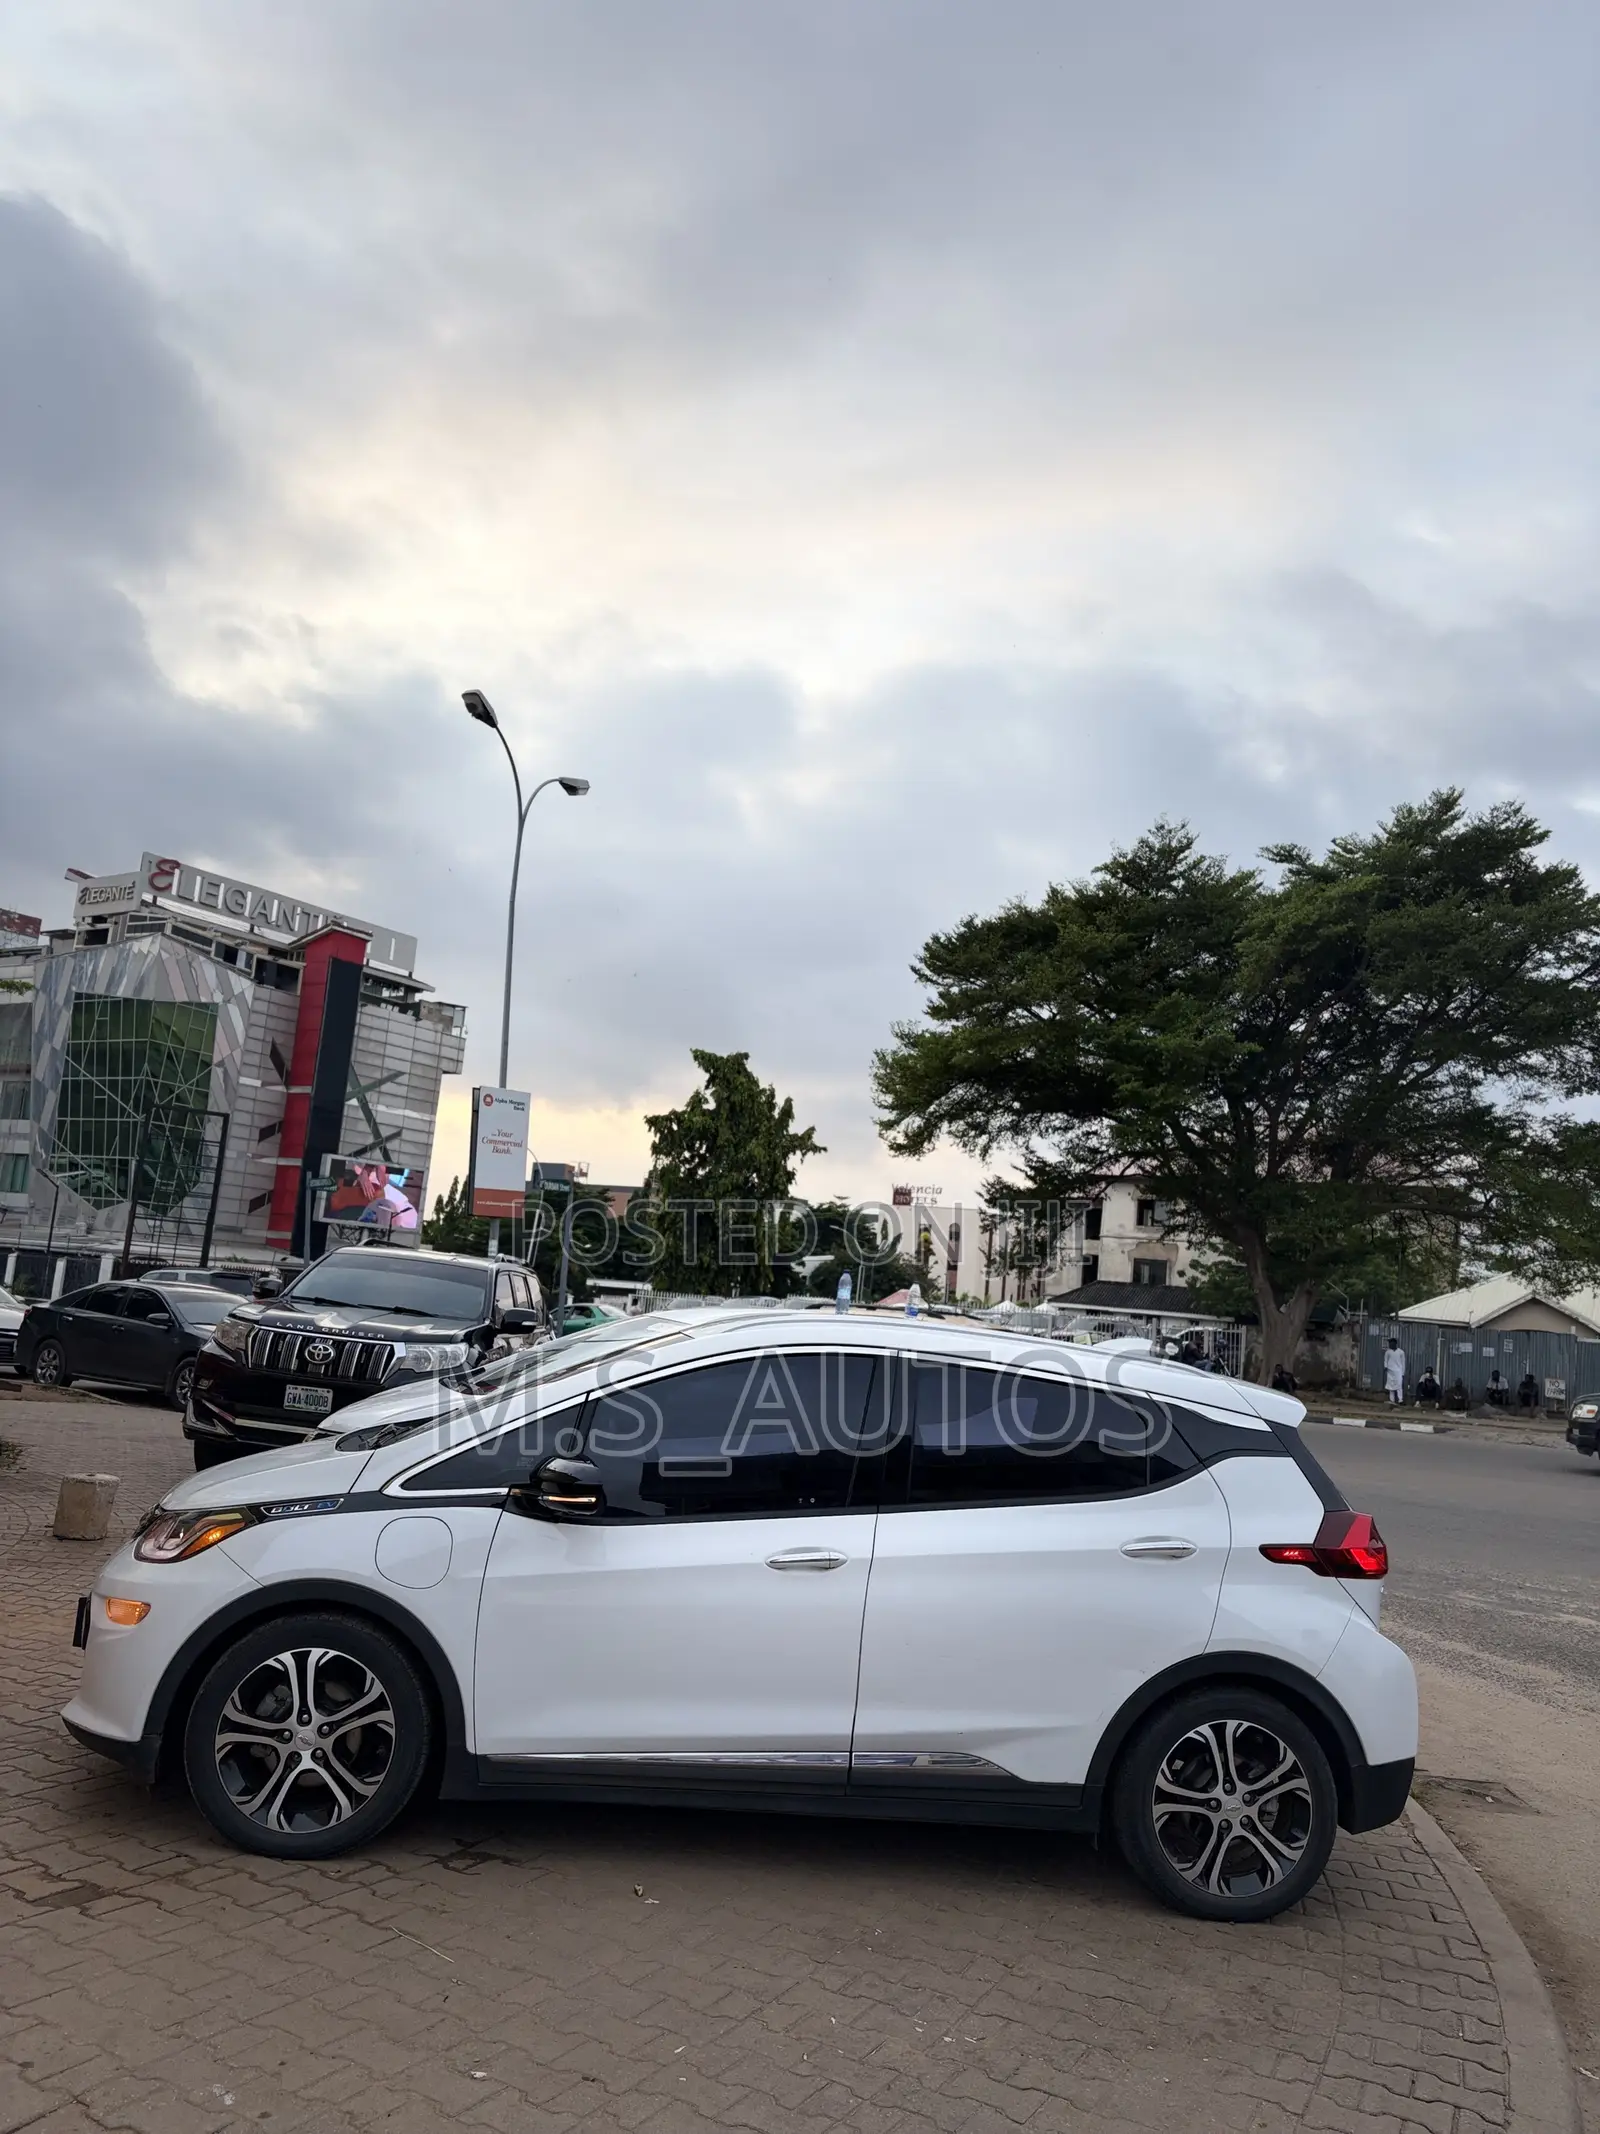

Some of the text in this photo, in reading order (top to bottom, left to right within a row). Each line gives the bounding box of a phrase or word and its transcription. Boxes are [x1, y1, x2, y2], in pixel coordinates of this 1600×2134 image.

[148, 858, 344, 932] ELEGANT
[481, 1136, 524, 1148] Commercial
[491, 1145, 513, 1155] Bank.
[892, 1182, 943, 1195] Valencia
[894, 1195, 938, 1205] HOTELS
[276, 1321, 385, 1339] LAND CRUISER
[1549, 1380, 1560, 1388] NO
[270, 1503, 313, 1514] BOLT
